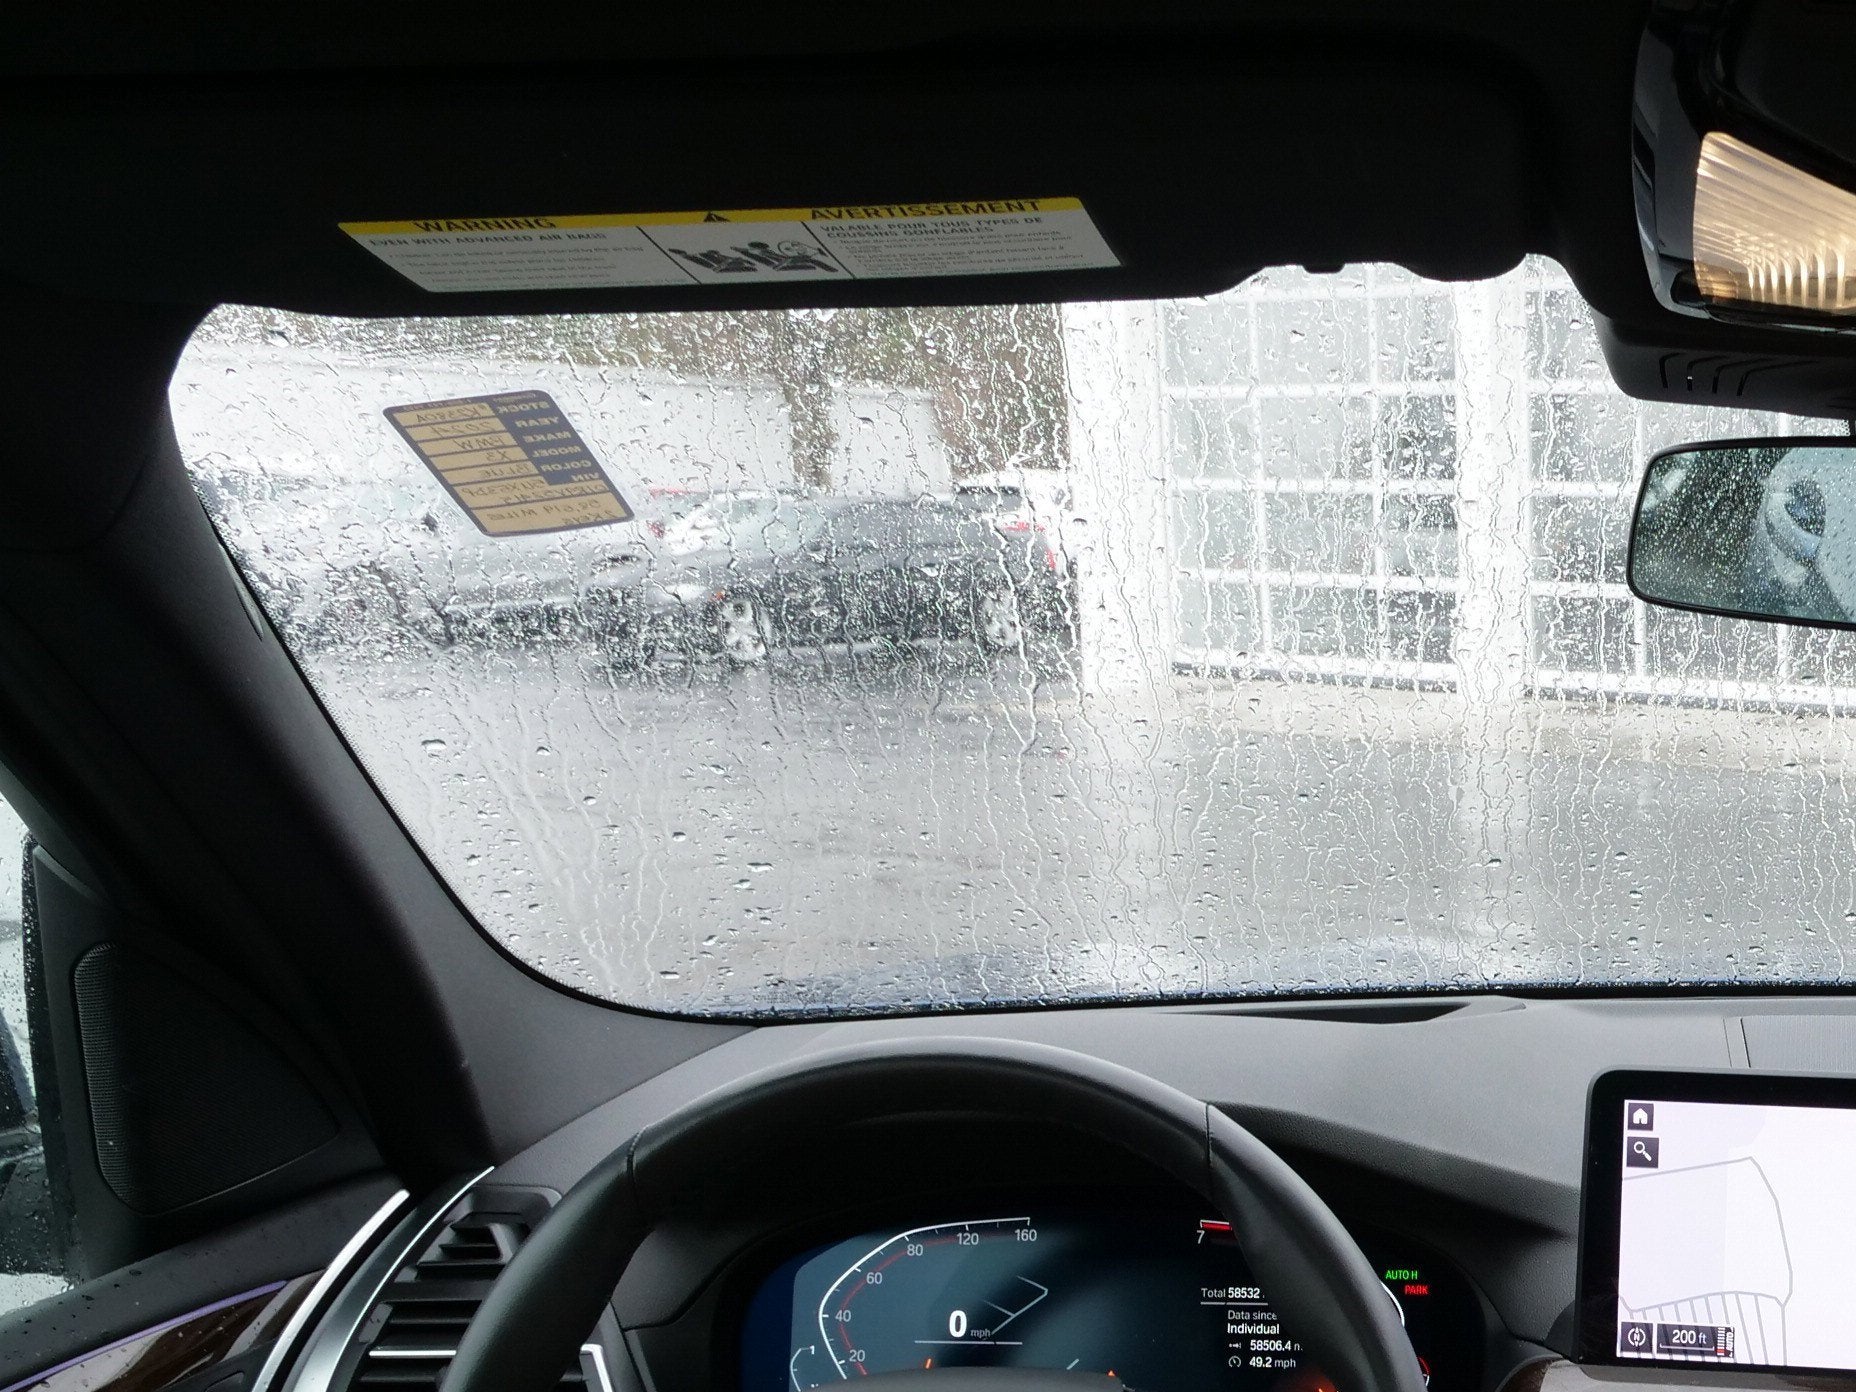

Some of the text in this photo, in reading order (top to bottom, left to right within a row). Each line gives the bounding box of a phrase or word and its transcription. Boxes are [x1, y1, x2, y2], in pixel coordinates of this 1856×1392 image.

[812, 201, 1040, 220] AVERTISSEMENT
[413, 217, 557, 233] WARNING
[956, 1232, 980, 1246] 120
[1014, 1228, 1038, 1242] 160
[1196, 1230, 1206, 1245] 7
[906, 1243, 924, 1257] 80
[866, 1272, 883, 1285] 60
[1385, 1269, 1418, 1281] AUTO H
[1200, 1287, 1261, 1299] Total 58532
[1404, 1284, 1429, 1296] PARK
[834, 1309, 852, 1323] 40
[1227, 1309, 1278, 1321] Data since
[949, 1310, 991, 1339] 0 mph
[1227, 1323, 1280, 1335] Individual
[1672, 1329, 1707, 1345] 200 ft
[1250, 1339, 1292, 1352] 58506.4
[849, 1349, 866, 1363] 20
[1249, 1356, 1297, 1370] 49.2 mph
